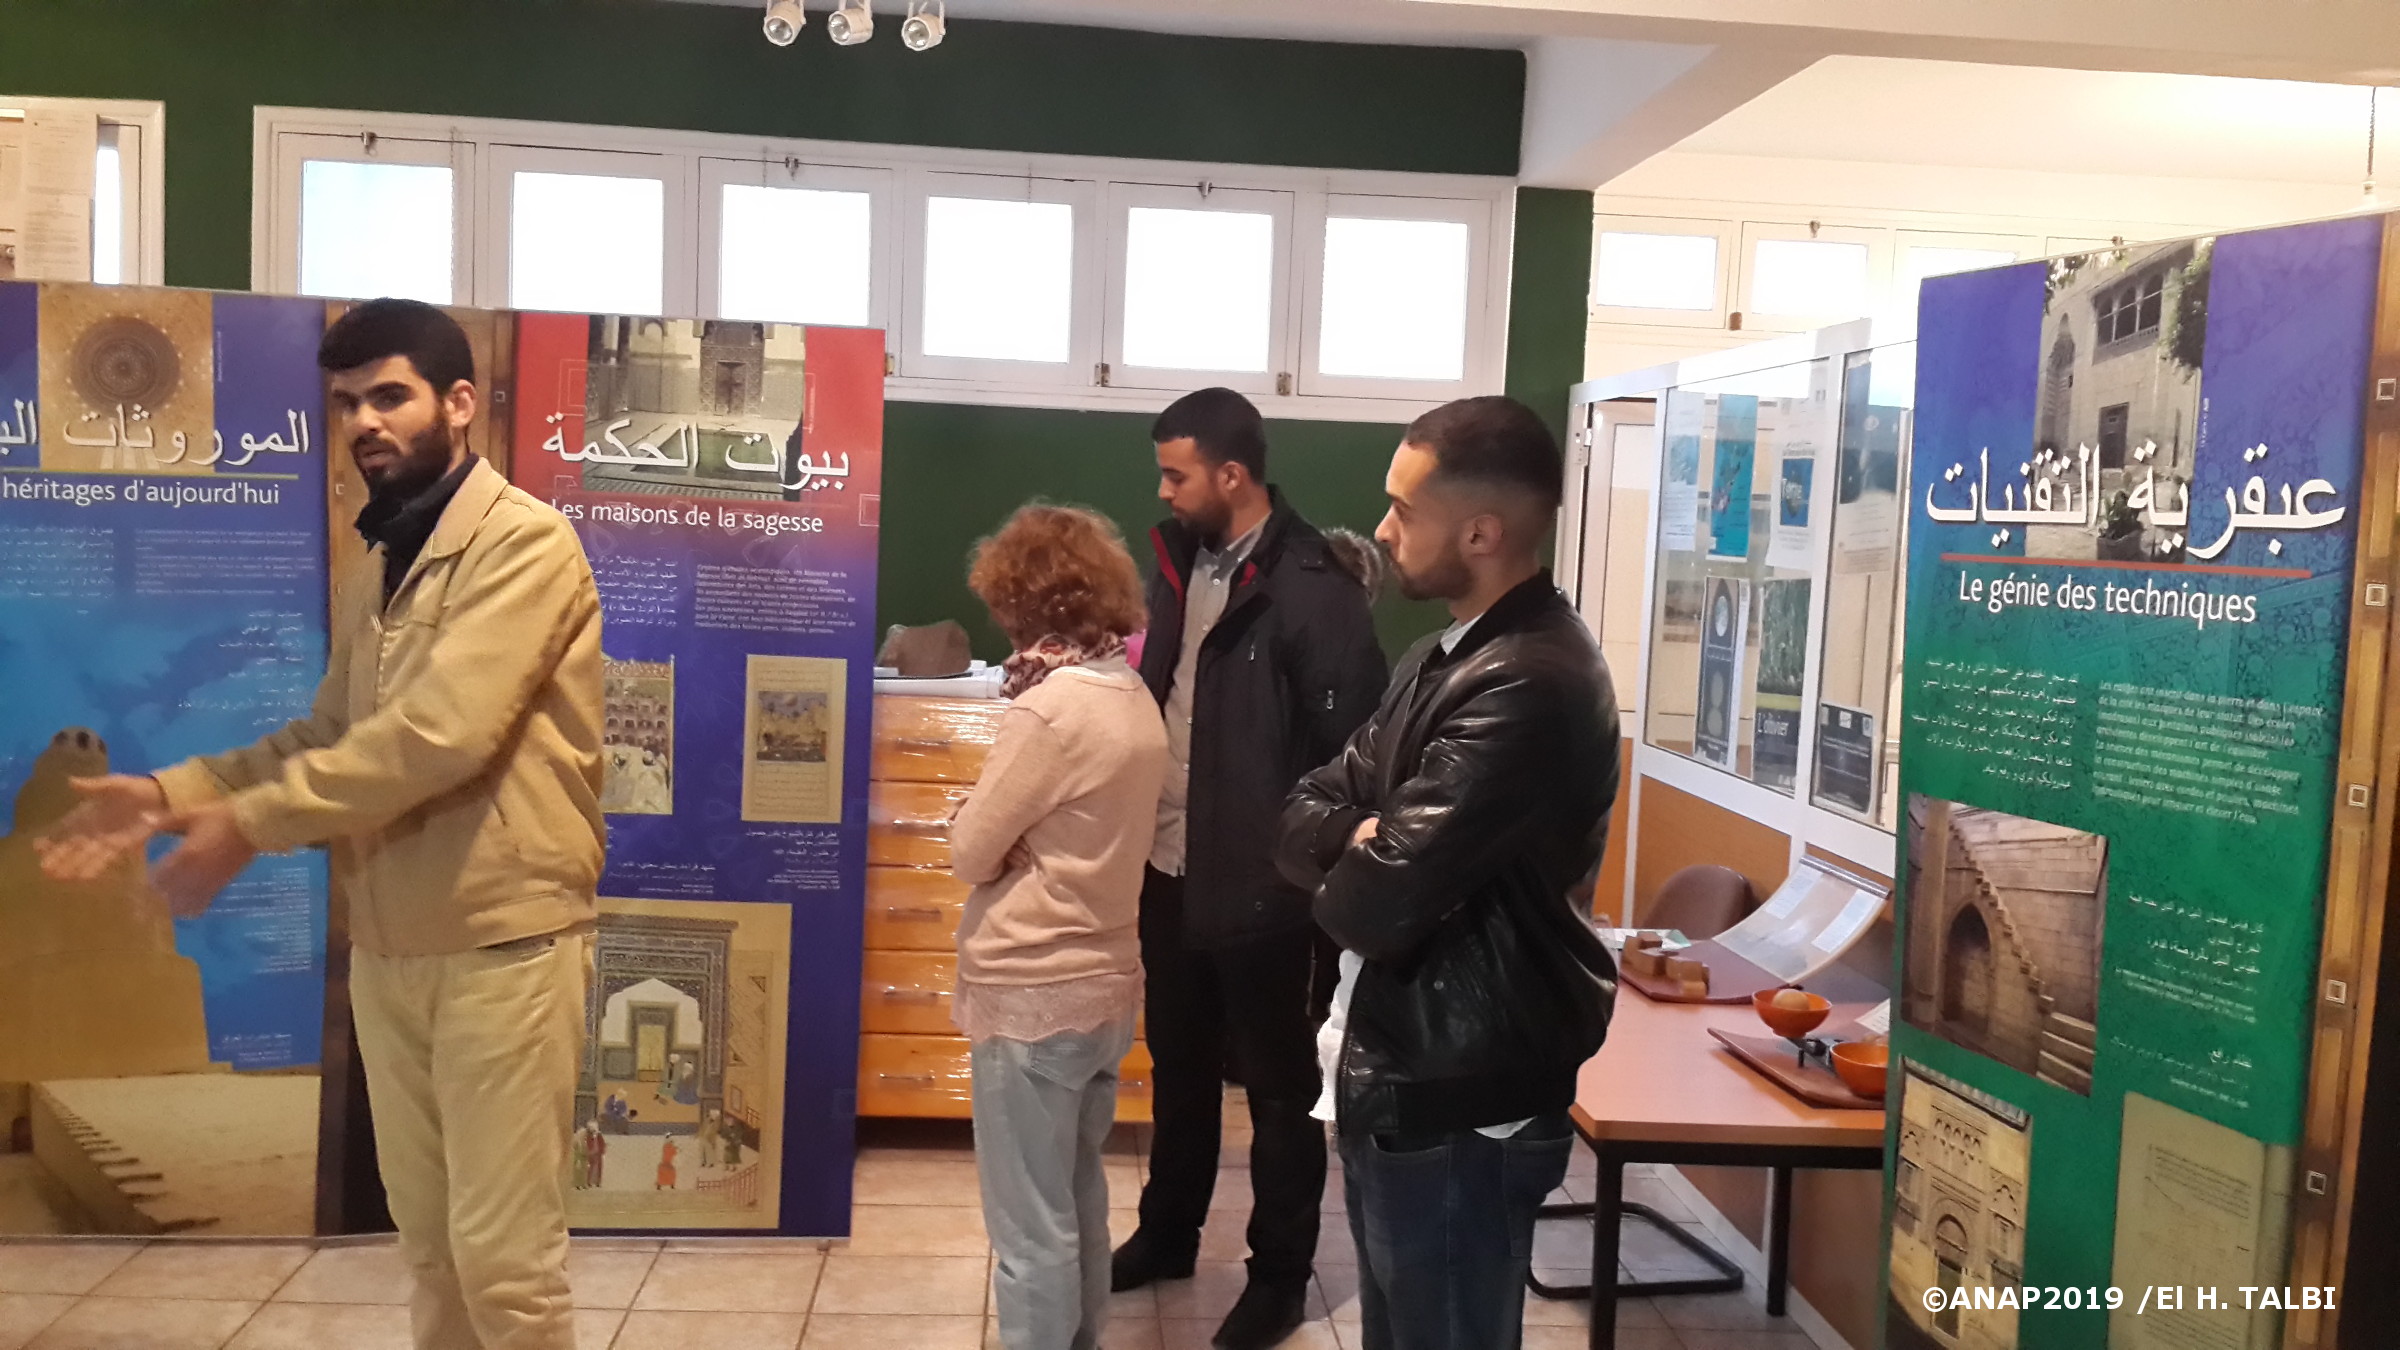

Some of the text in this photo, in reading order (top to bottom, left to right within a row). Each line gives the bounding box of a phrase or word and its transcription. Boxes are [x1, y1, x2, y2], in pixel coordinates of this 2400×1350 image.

[542, 411, 849, 490] بيوت الحكمة
[2, 476, 280, 508] héritages d'aujourd'hui
[591, 503, 679, 526] maisons
[685, 505, 711, 527] de
[718, 507, 736, 528] la
[743, 512, 824, 536] sagesse
[1926, 442, 2099, 548] التقنيات
[2127, 440, 2346, 559] عبقرية
[1960, 570, 2258, 630] Le génie des techniques
